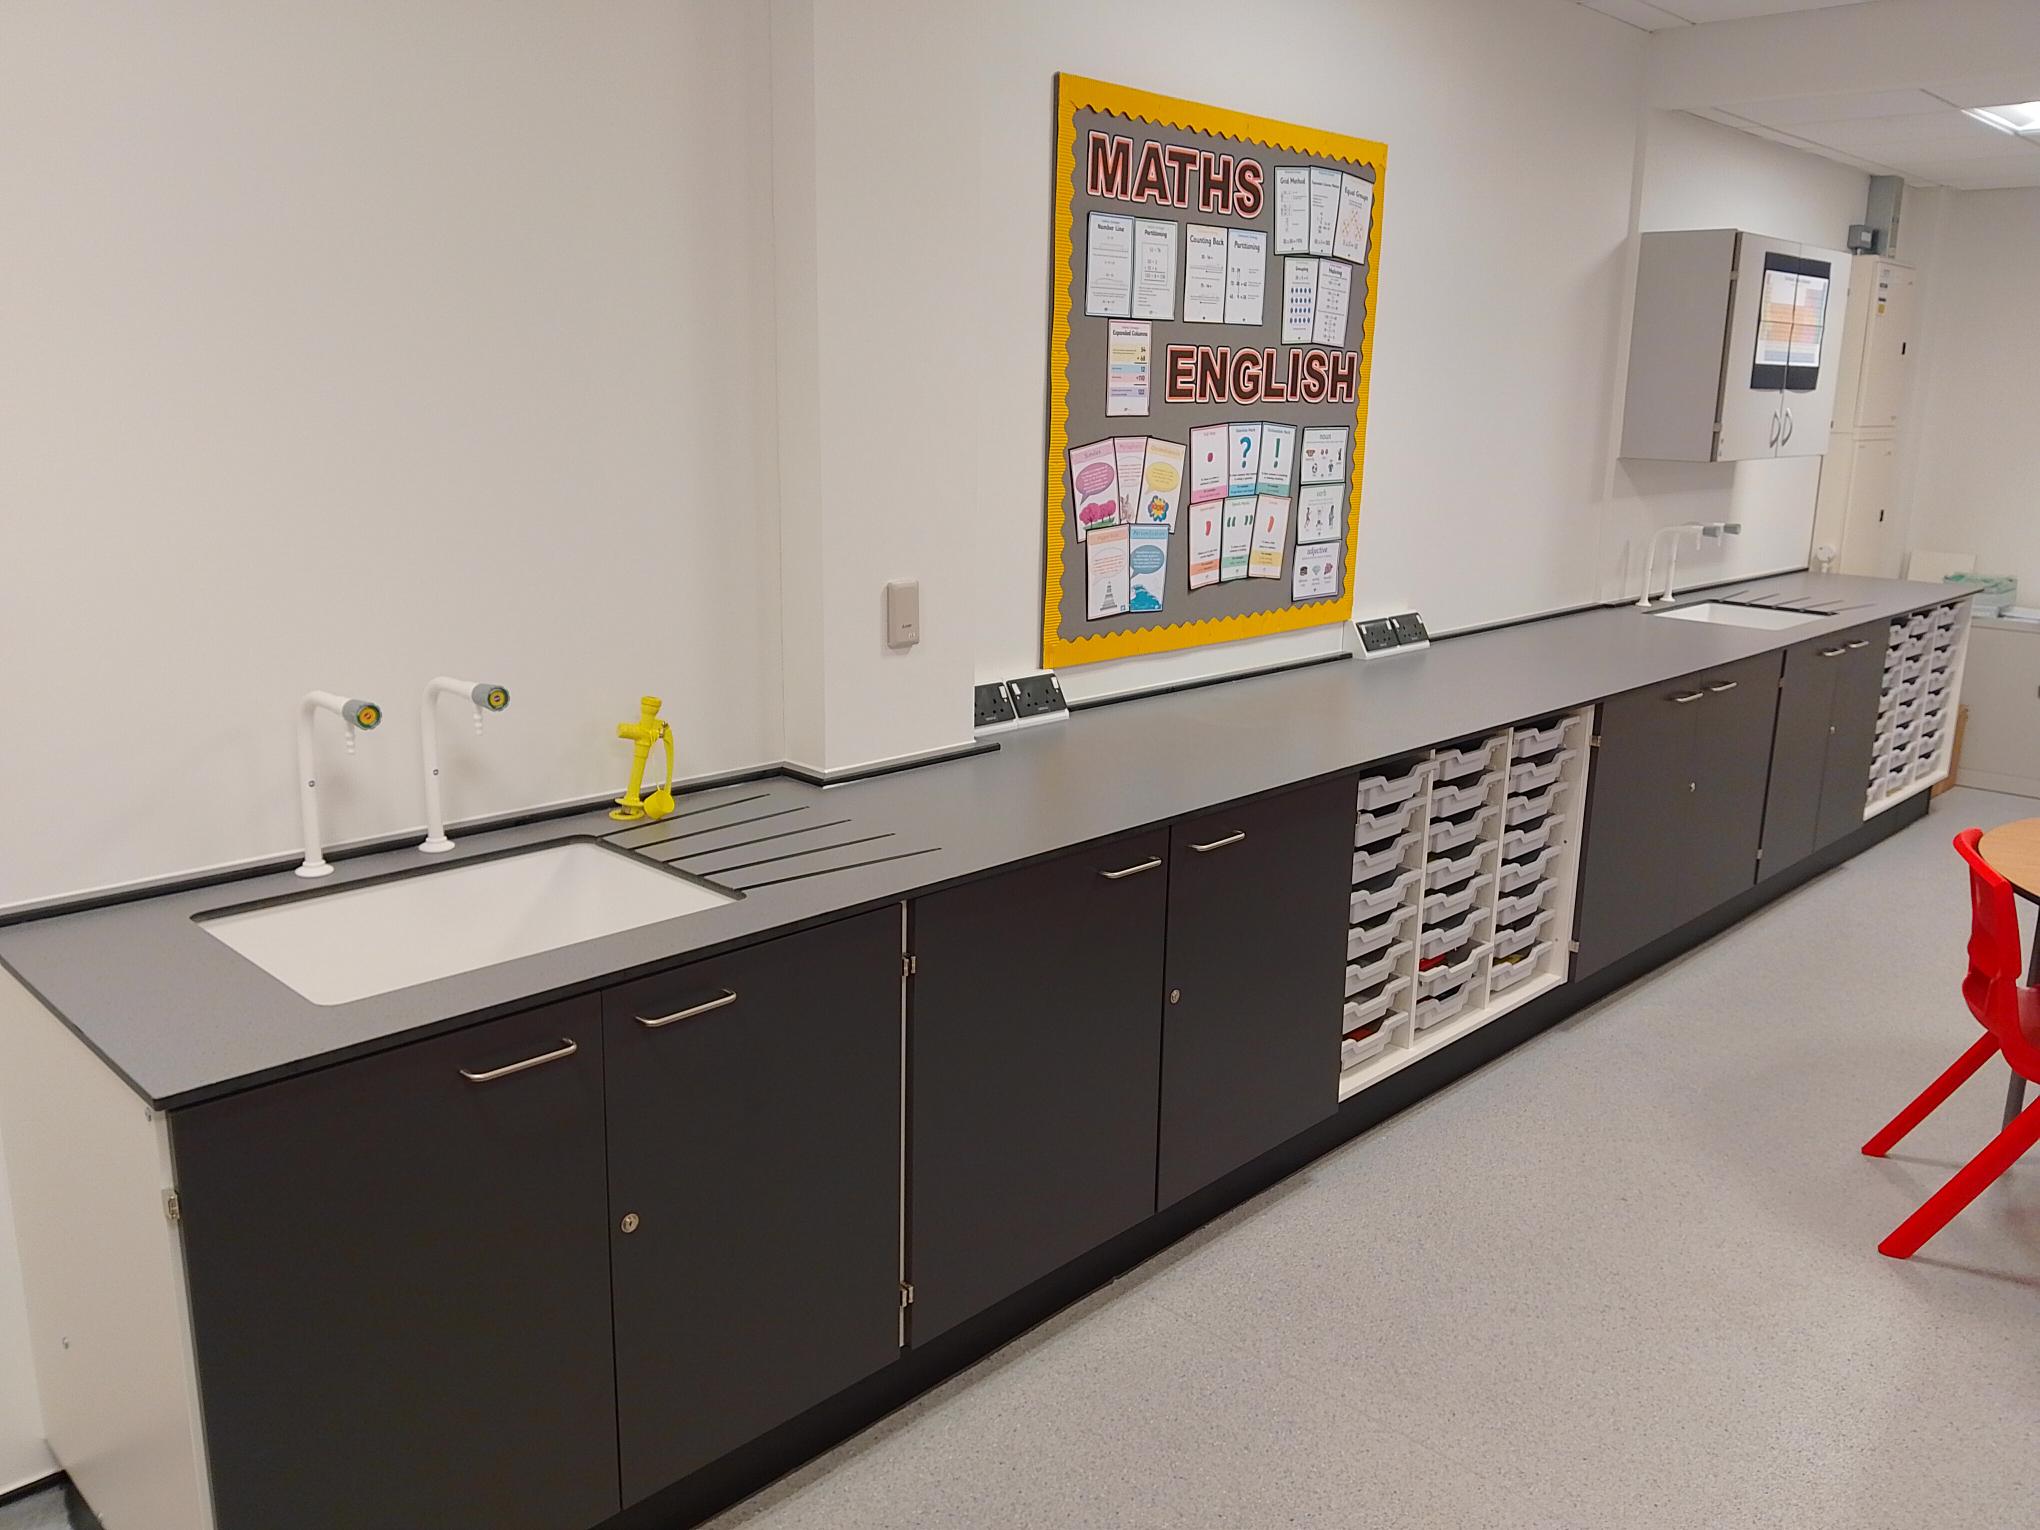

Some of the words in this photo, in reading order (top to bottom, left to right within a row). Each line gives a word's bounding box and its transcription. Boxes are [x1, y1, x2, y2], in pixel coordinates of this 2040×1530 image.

[1086, 129, 1265, 219] MATHS
[1290, 177, 1306, 185] Method
[1344, 186, 1355, 196] Equal
[1356, 190, 1369, 203] Groups
[1097, 223, 1114, 231] Number
[1115, 225, 1125, 233] Line
[1144, 229, 1168, 239] Partitioning
[1189, 234, 1212, 247] Counting
[1212, 237, 1224, 246] Back
[1234, 240, 1260, 253] Partitioning
[1112, 329, 1131, 337] Expanded
[1164, 343, 1359, 405] ENGLISH
[1306, 546, 1328, 557] adjective
